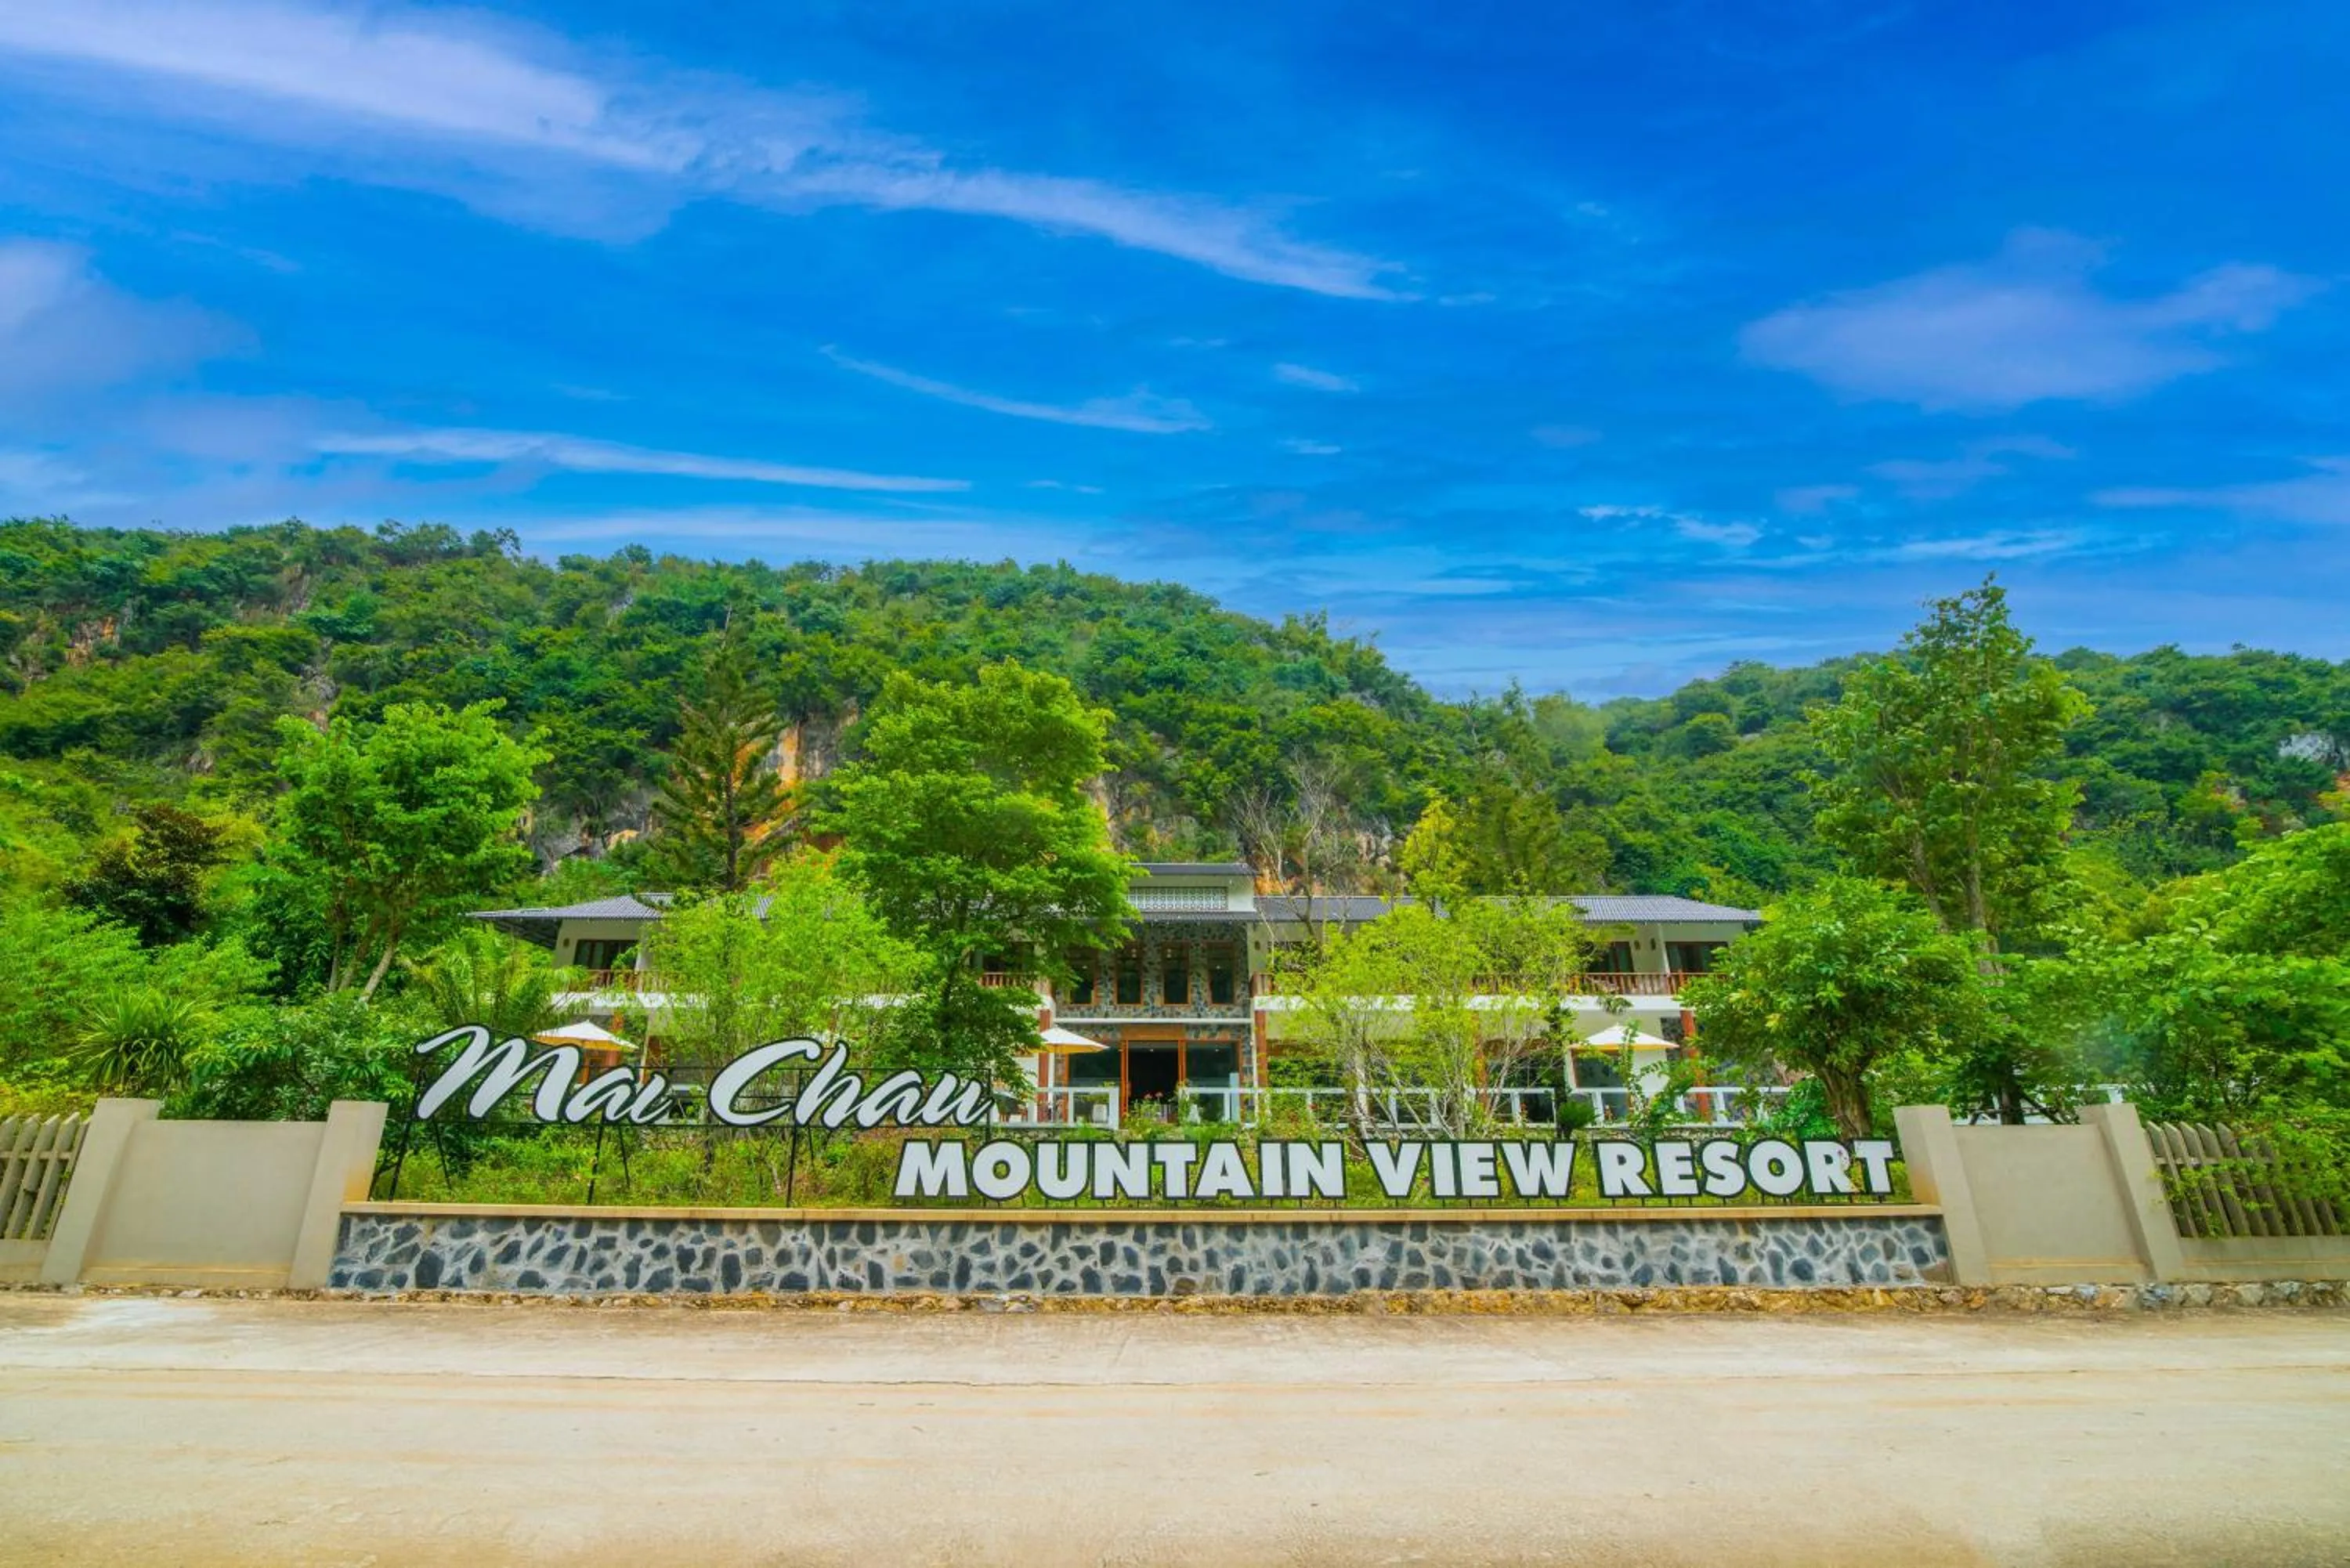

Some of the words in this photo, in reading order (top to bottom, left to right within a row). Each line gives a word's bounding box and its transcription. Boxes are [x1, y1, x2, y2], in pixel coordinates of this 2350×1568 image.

[416, 1024, 674, 1125] Mai
[708, 1036, 996, 1129] Chau
[892, 1139, 1346, 1200] MOUNTAIN
[1363, 1139, 1574, 1198] VIEW
[1593, 1137, 1894, 1198] RESORT
